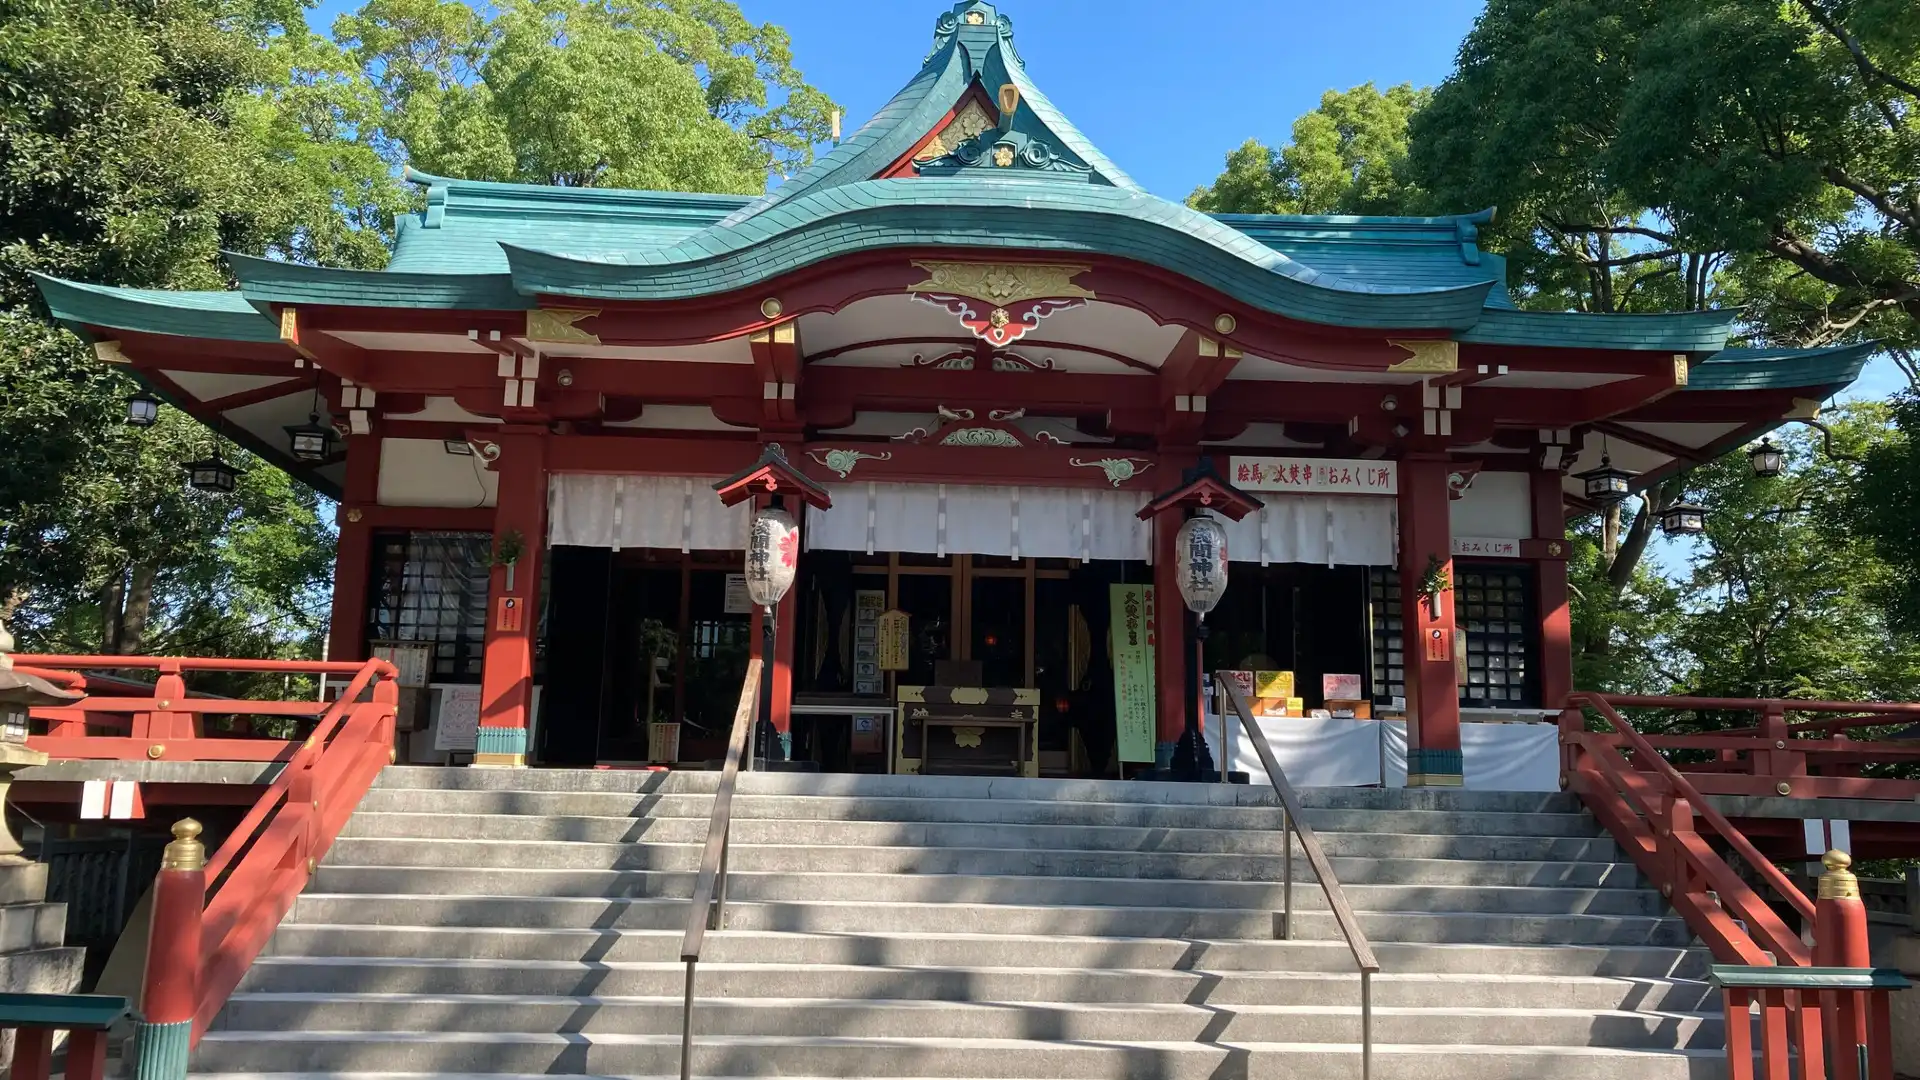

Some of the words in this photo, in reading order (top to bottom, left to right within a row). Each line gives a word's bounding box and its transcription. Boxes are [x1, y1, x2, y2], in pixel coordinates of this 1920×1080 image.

[1237, 463, 1263, 485] 絵馬
[1328, 466, 1390, 489] おみくじ所
[1461, 541, 1513, 555] おみくじ所
